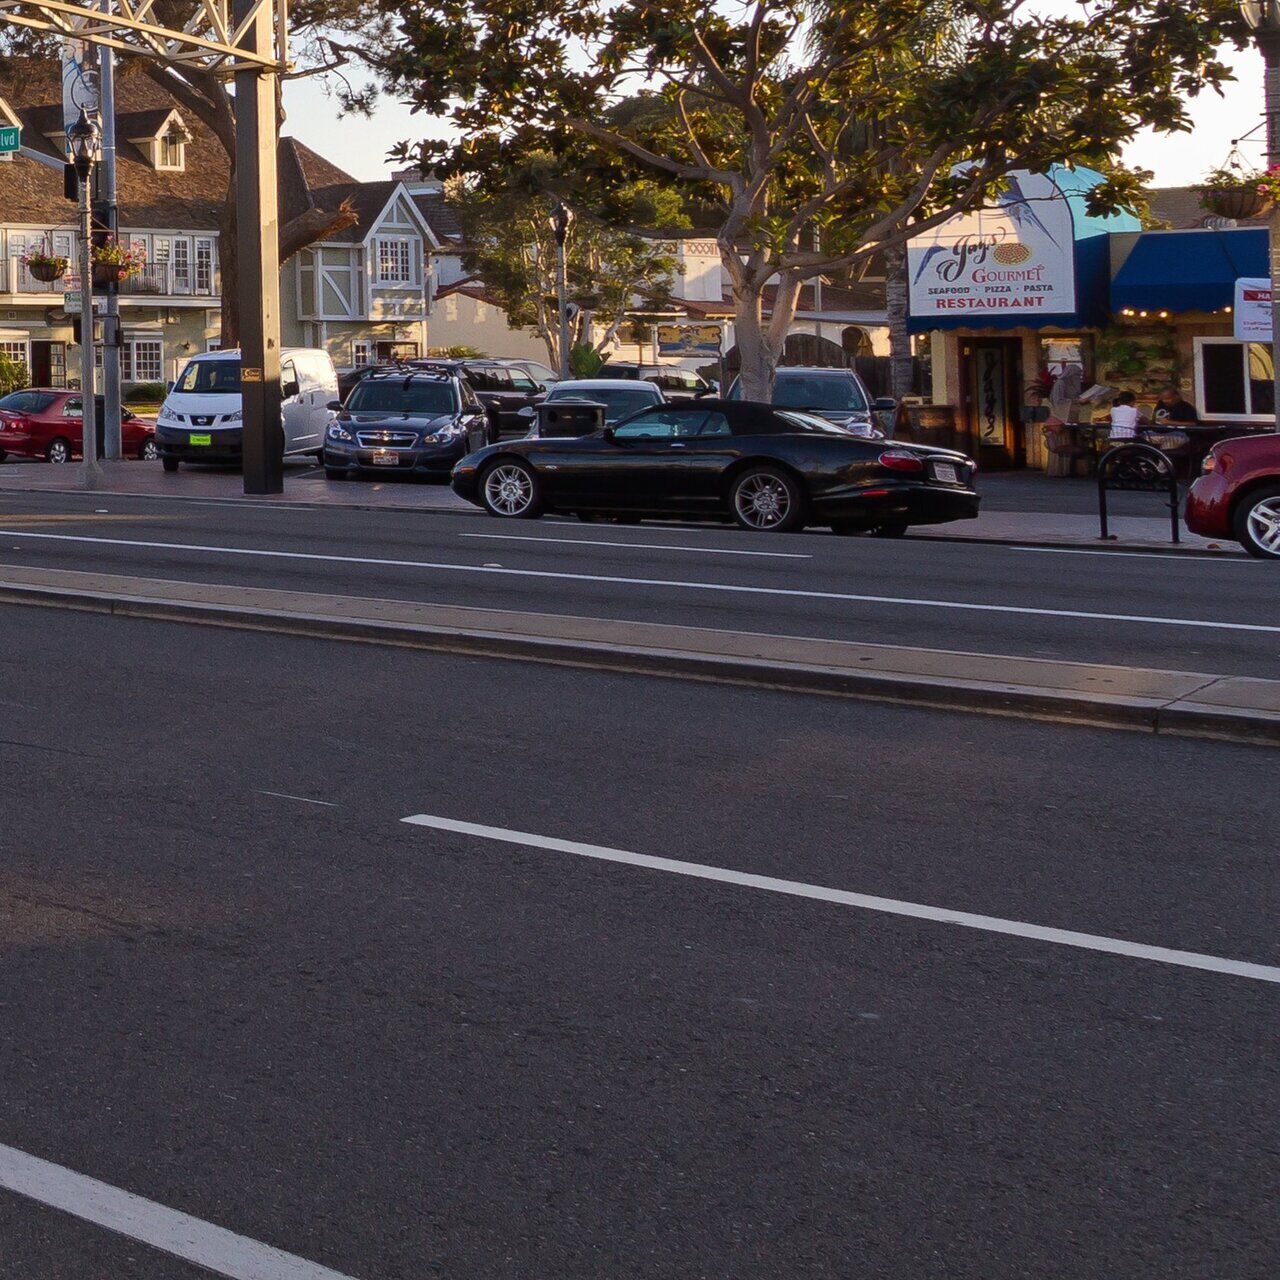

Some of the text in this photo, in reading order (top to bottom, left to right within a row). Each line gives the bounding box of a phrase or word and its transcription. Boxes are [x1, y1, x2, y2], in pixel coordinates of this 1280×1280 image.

[928, 284, 1054, 295] SEAFOOD PIZZA PASTA
[936, 296, 1045, 309] RESTAURANT
